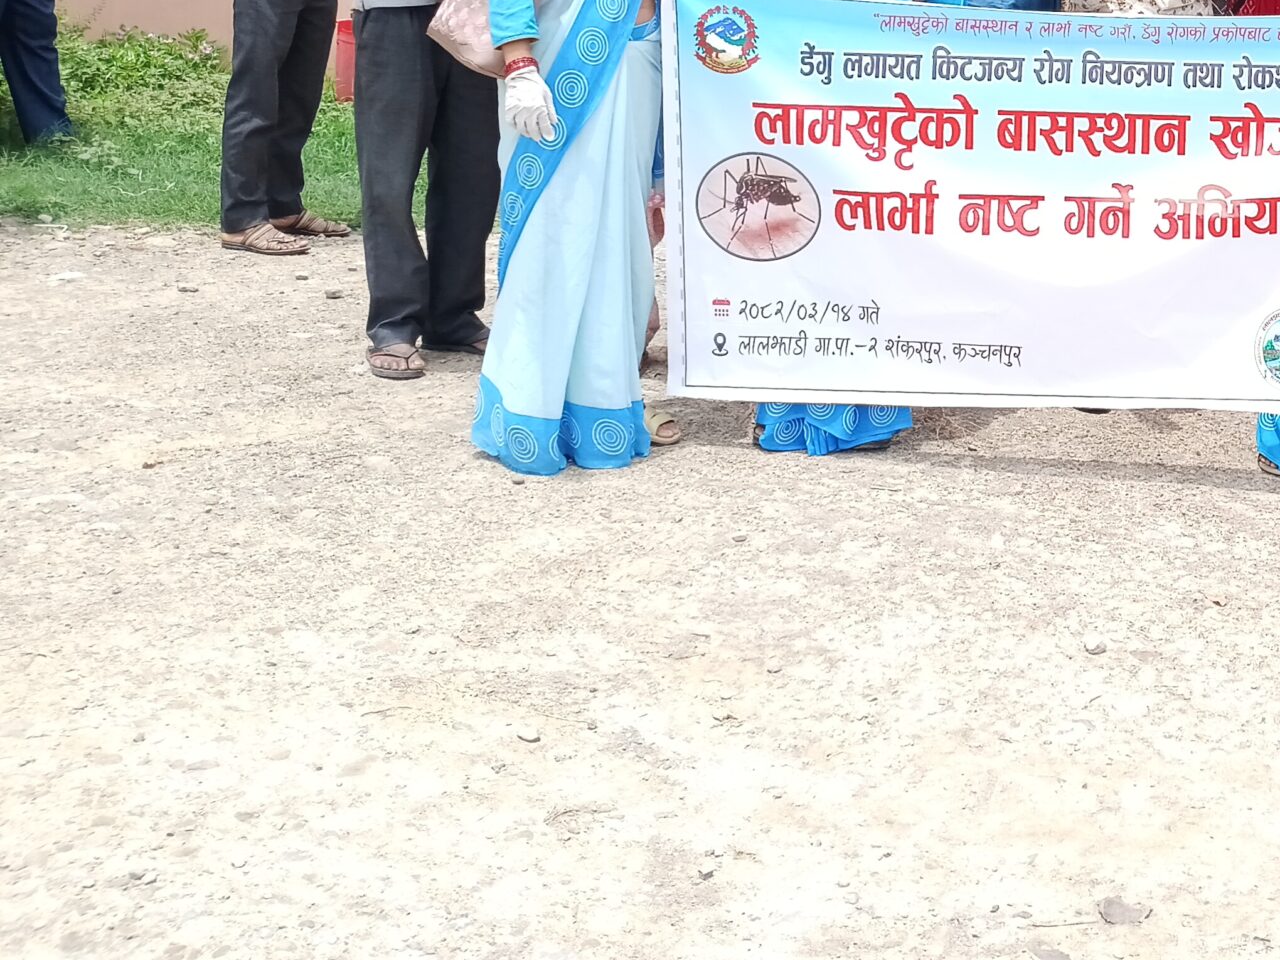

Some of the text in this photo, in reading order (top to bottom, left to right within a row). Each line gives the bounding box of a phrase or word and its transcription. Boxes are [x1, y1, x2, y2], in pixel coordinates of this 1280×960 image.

[955, 18, 1018, 38] बासस्थान
[1025, 22, 1033, 39] र
[1039, 20, 1072, 39] लार्भा
[1078, 24, 1104, 39] नष्ट
[1167, 22, 1206, 45] रोगको
[1210, 22, 1271, 44] प्रकोपबाट
[843, 50, 923, 82] लगायत
[932, 46, 1025, 82] किटजन्य
[1034, 50, 1072, 84] रोग
[1081, 50, 1175, 87] नियन्त्रण
[1183, 62, 1224, 88] तथा
[752, 92, 978, 170] लामखुट्टेको
[997, 108, 1191, 157] बासस्थान
[832, 180, 938, 235] लार्भा
[959, 194, 1045, 238] नष्ट
[1064, 183, 1134, 239] गर्ने
[739, 299, 880, 325] २०८२/०३/१४ गते
[738, 330, 809, 358] लालझाडी
[953, 339, 1024, 368] कञ्चनपुर
